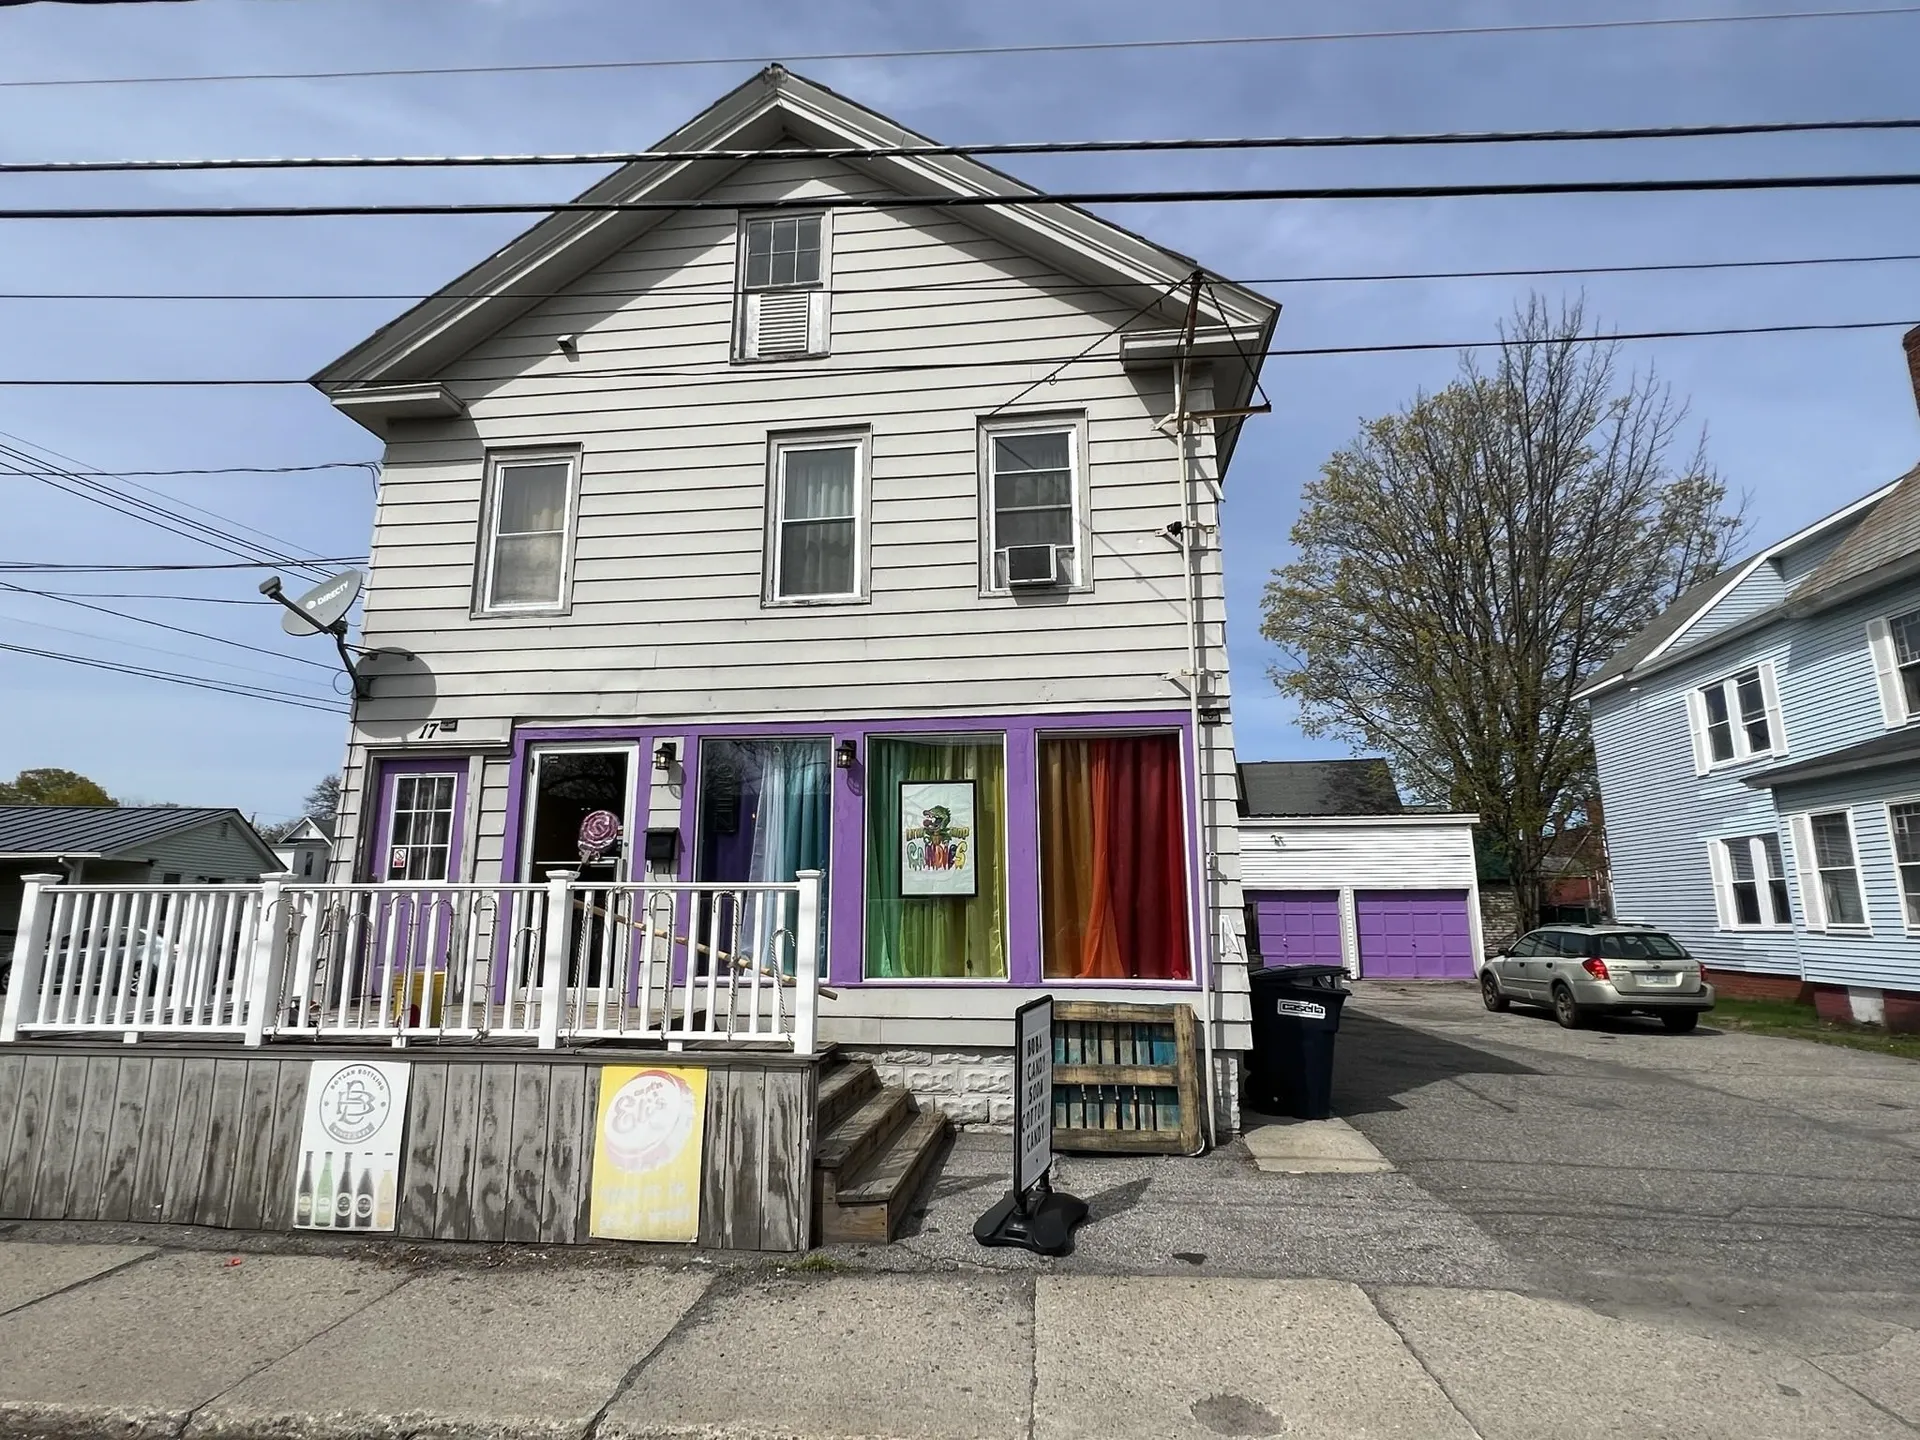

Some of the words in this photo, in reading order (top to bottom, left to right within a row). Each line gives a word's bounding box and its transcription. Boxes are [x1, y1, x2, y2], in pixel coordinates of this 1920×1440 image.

[418, 722, 440, 739] 17
[1027, 1054, 1046, 1082] CANDY
[1028, 1078, 1044, 1106] SODA
[1021, 1099, 1045, 1134] COTTON
[1026, 1121, 1045, 1153] CANDY
